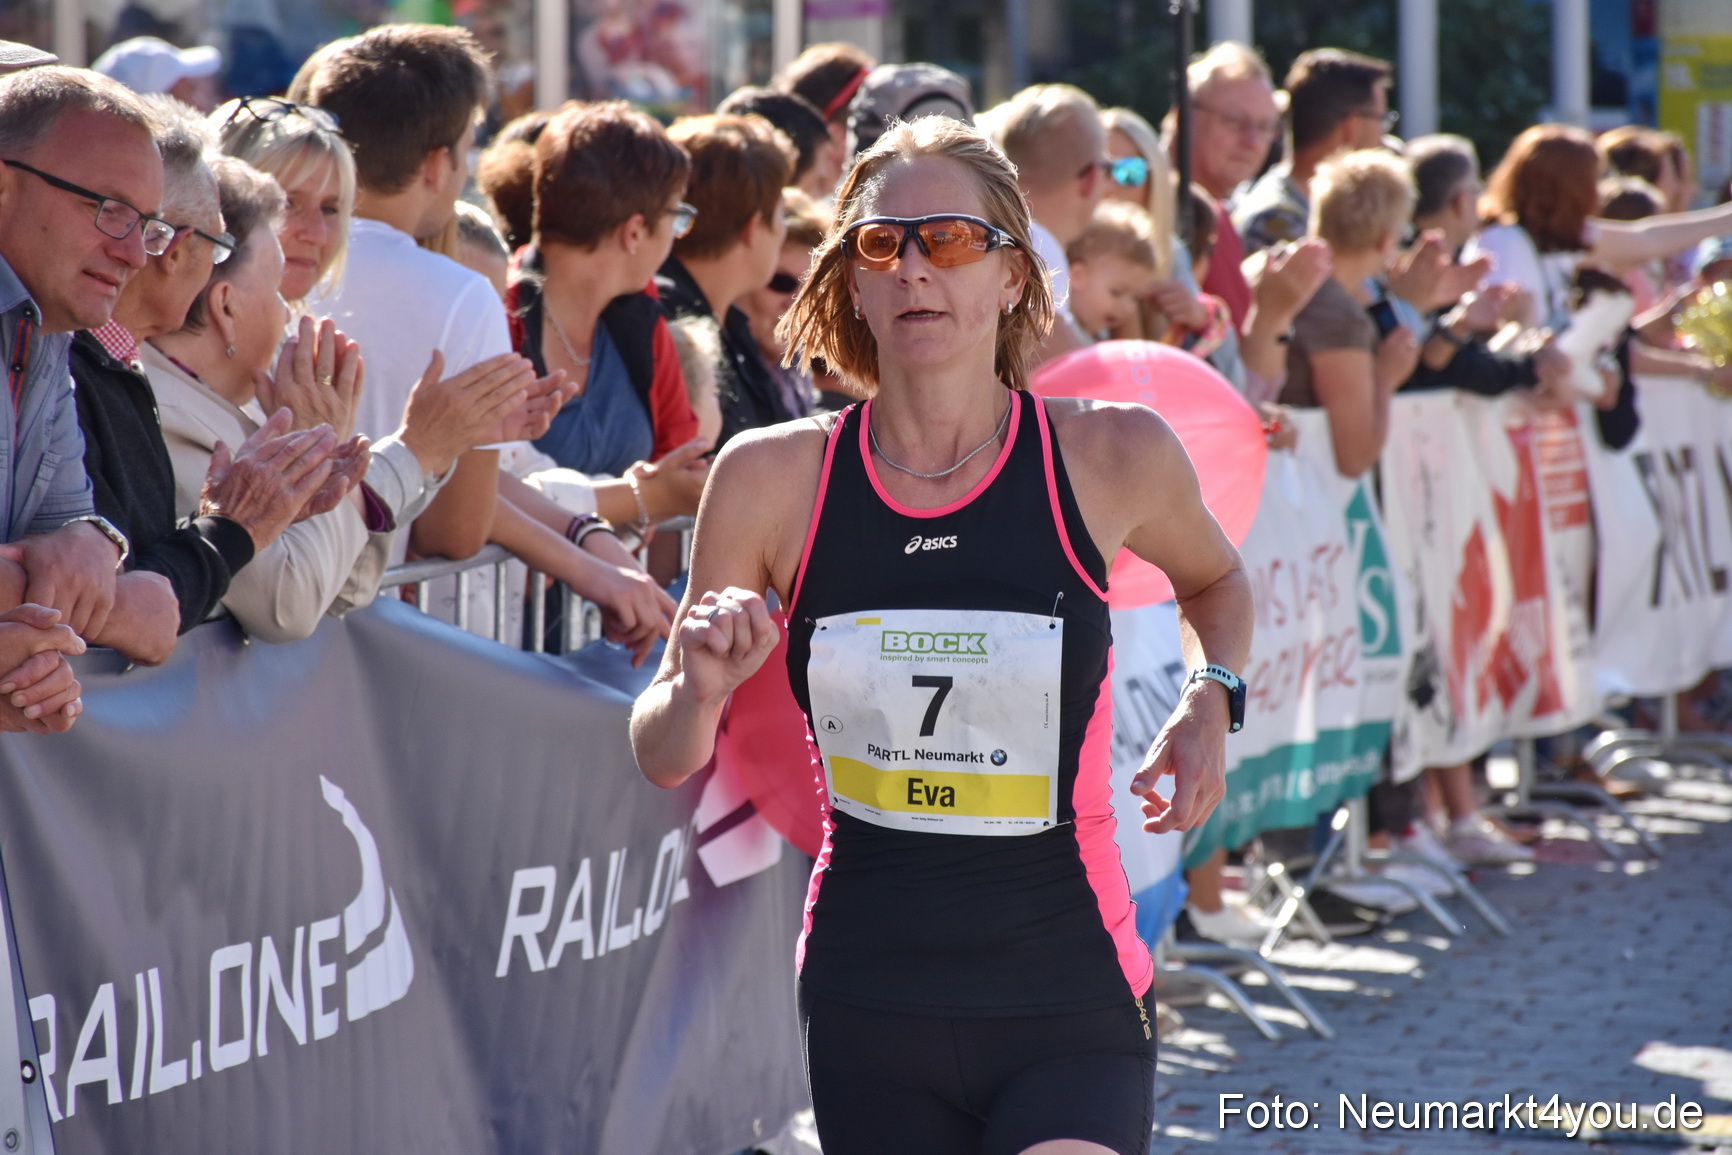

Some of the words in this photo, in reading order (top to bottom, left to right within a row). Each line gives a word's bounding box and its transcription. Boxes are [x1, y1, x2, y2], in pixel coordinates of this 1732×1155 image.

[921, 535, 957, 551] asics
[881, 630, 988, 655] BOCK
[880, 654, 913, 662] inspired
[914, 655, 924, 663] by
[952, 656, 989, 665] concepts
[911, 675, 953, 737] 7
[827, 720, 837, 730] A
[867, 743, 911, 762] PARTL
[914, 749, 985, 764] Neumarkt
[907, 777, 956, 808] Eva
